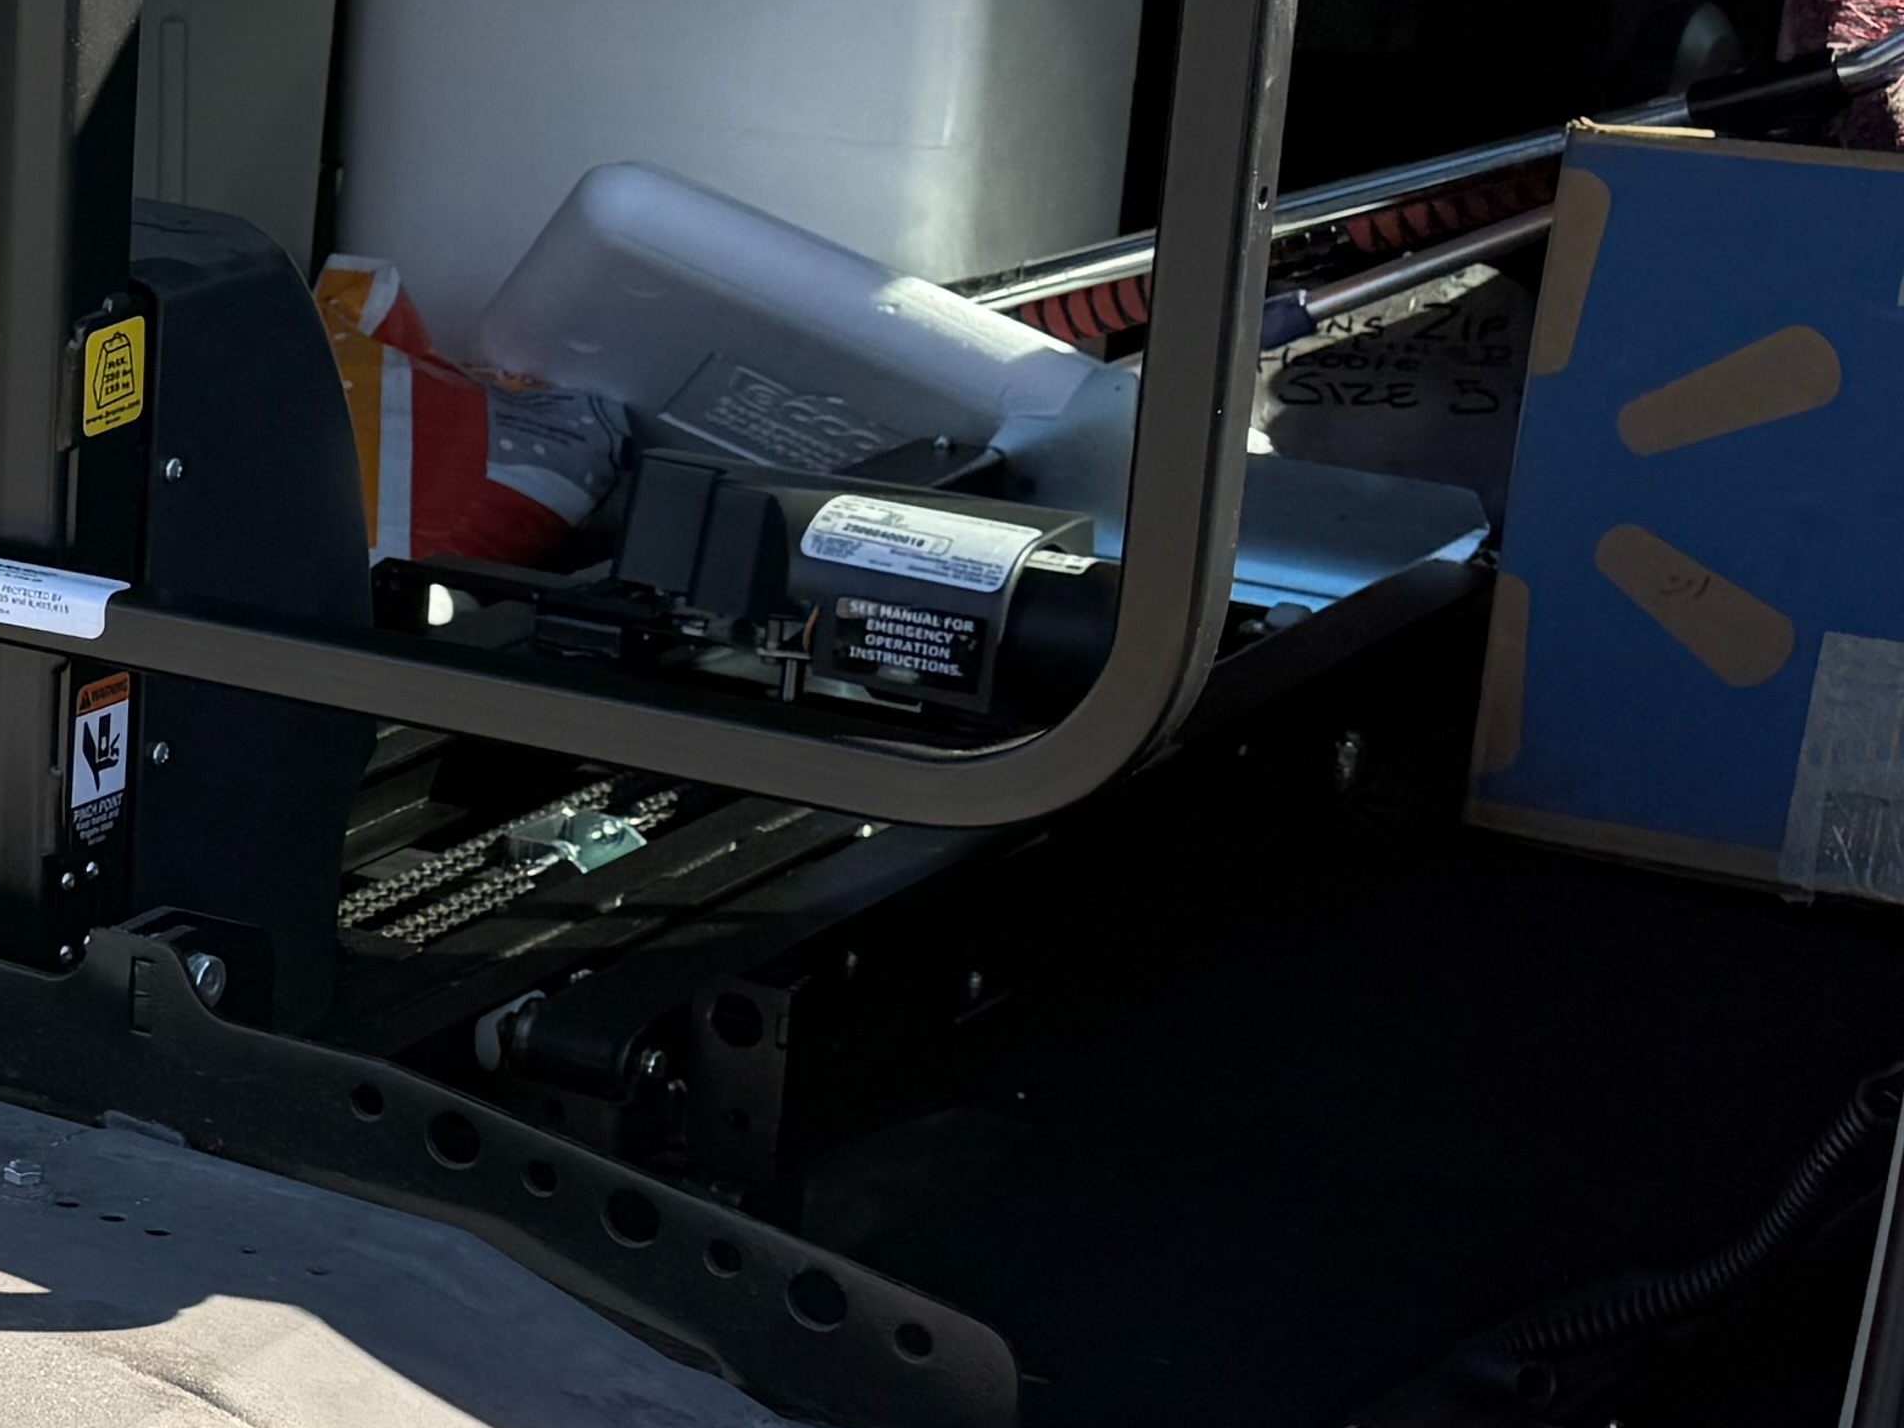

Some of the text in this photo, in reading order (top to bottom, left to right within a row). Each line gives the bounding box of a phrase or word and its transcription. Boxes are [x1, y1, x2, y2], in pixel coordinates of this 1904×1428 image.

[1413, 302, 1510, 342] ZIP
[1278, 371, 1419, 408] SIZE
[849, 600, 975, 633] SEE MANUAL FOR
[865, 619, 955, 646] EMERGENCY
[848, 645, 963, 678] INSTRUCTIONS.
[864, 633, 951, 660] OPERATION
